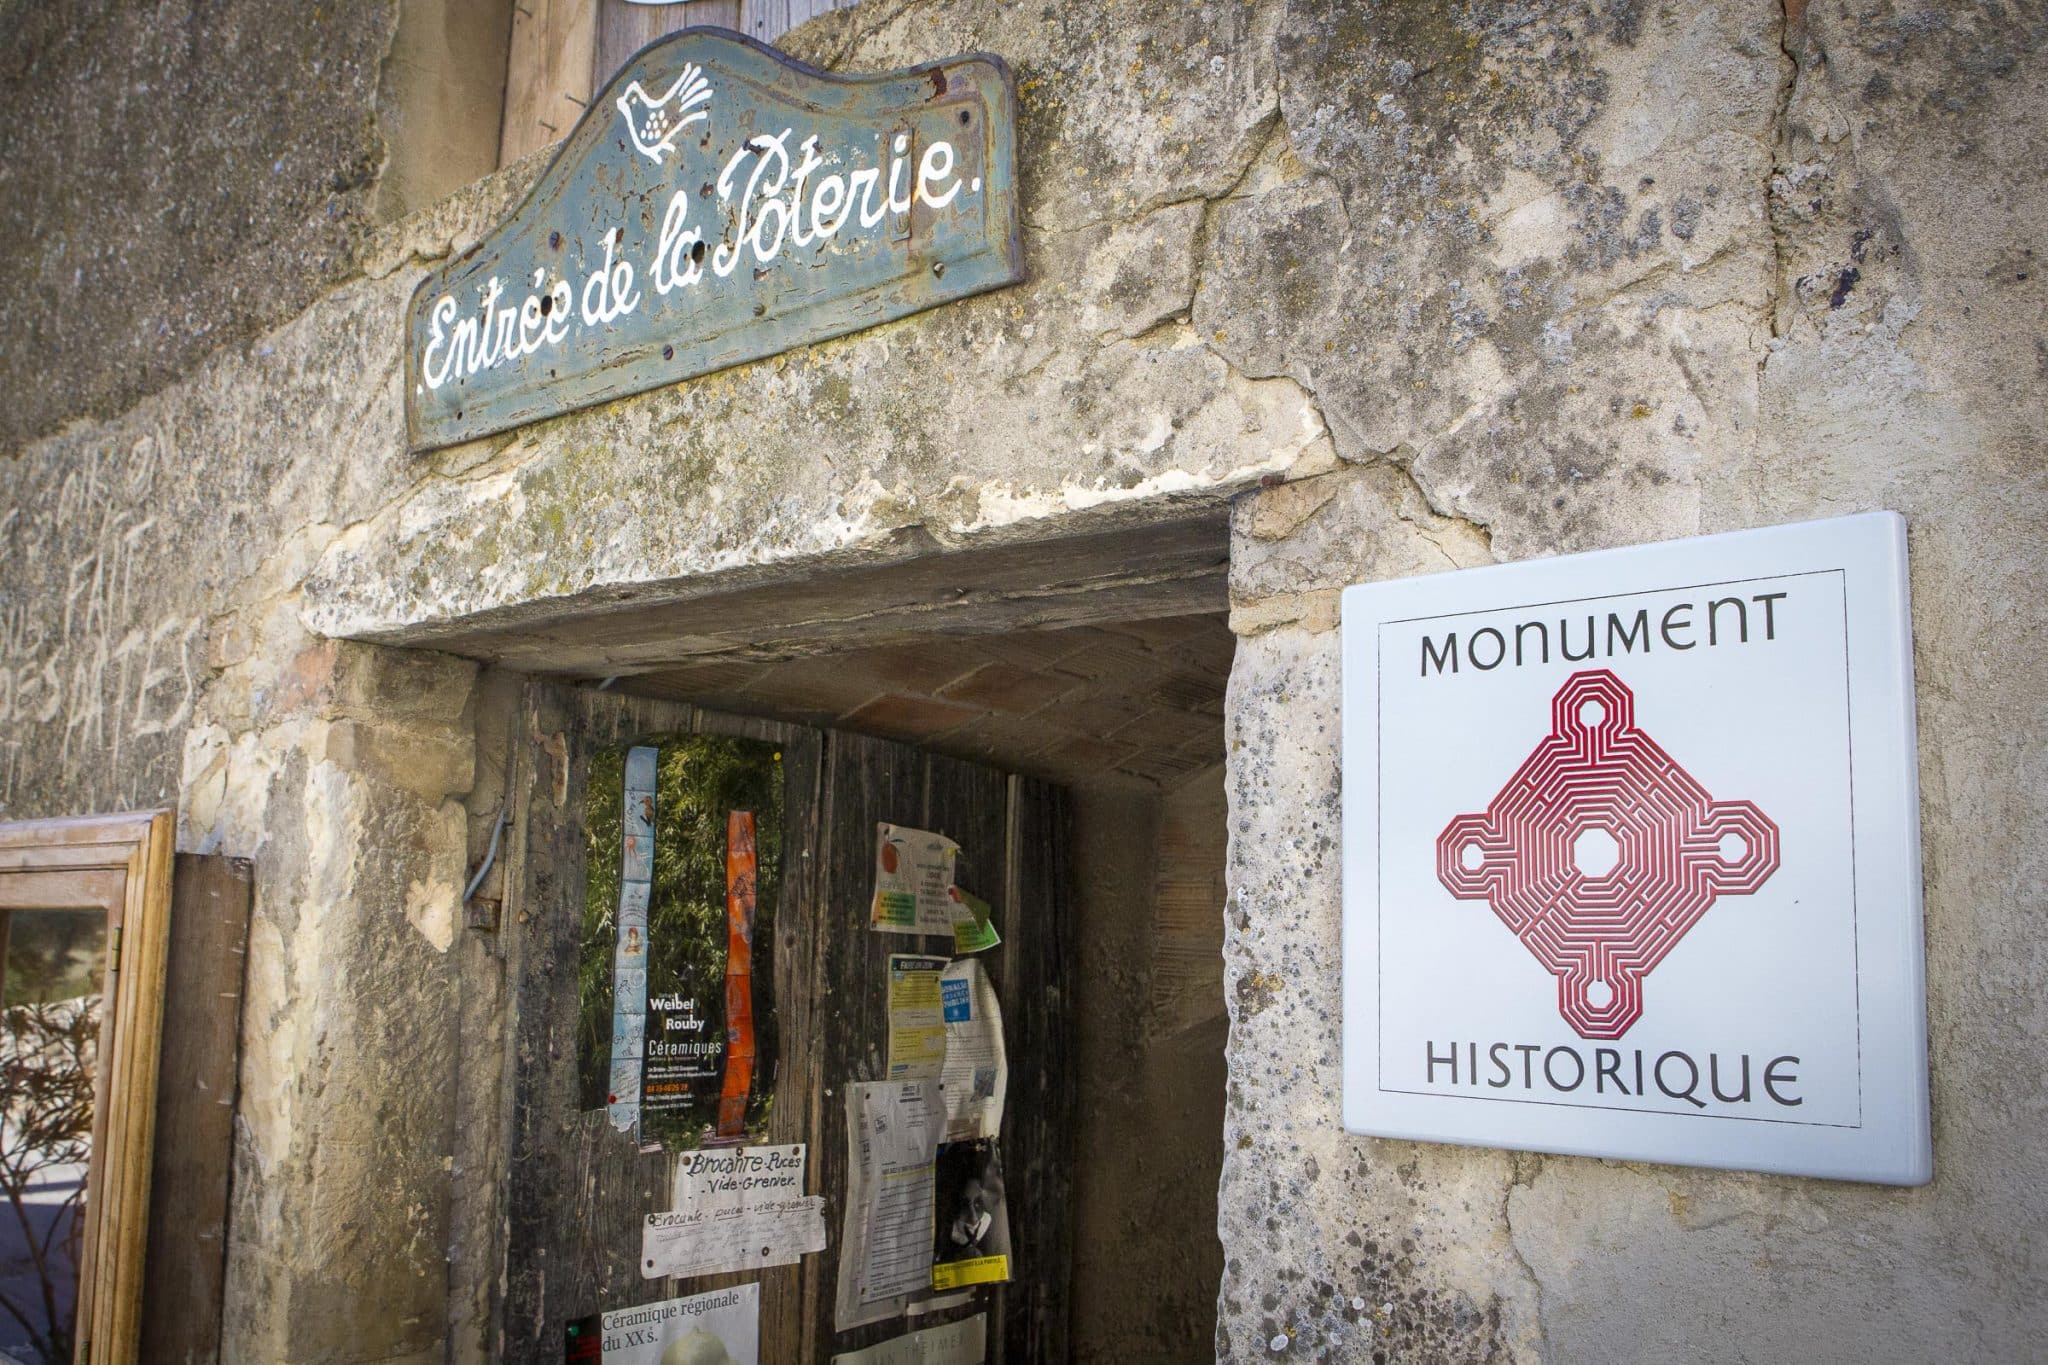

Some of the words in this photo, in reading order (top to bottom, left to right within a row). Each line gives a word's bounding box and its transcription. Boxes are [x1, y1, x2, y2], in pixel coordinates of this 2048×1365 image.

[580, 226, 640, 327] de
[650, 190, 705, 295] la
[712, 127, 981, 278] Poterie.
[1420, 592, 1788, 677] MONUMENT
[650, 992, 694, 1010] Weibel
[666, 1014, 704, 1032] Rouby
[649, 1039, 722, 1057] Céramiques
[1426, 1040, 1803, 1108] HISTORIQUE
[602, 1304, 677, 1331] Céramique
[680, 1291, 739, 1316] régionale
[602, 1335, 621, 1352] du
